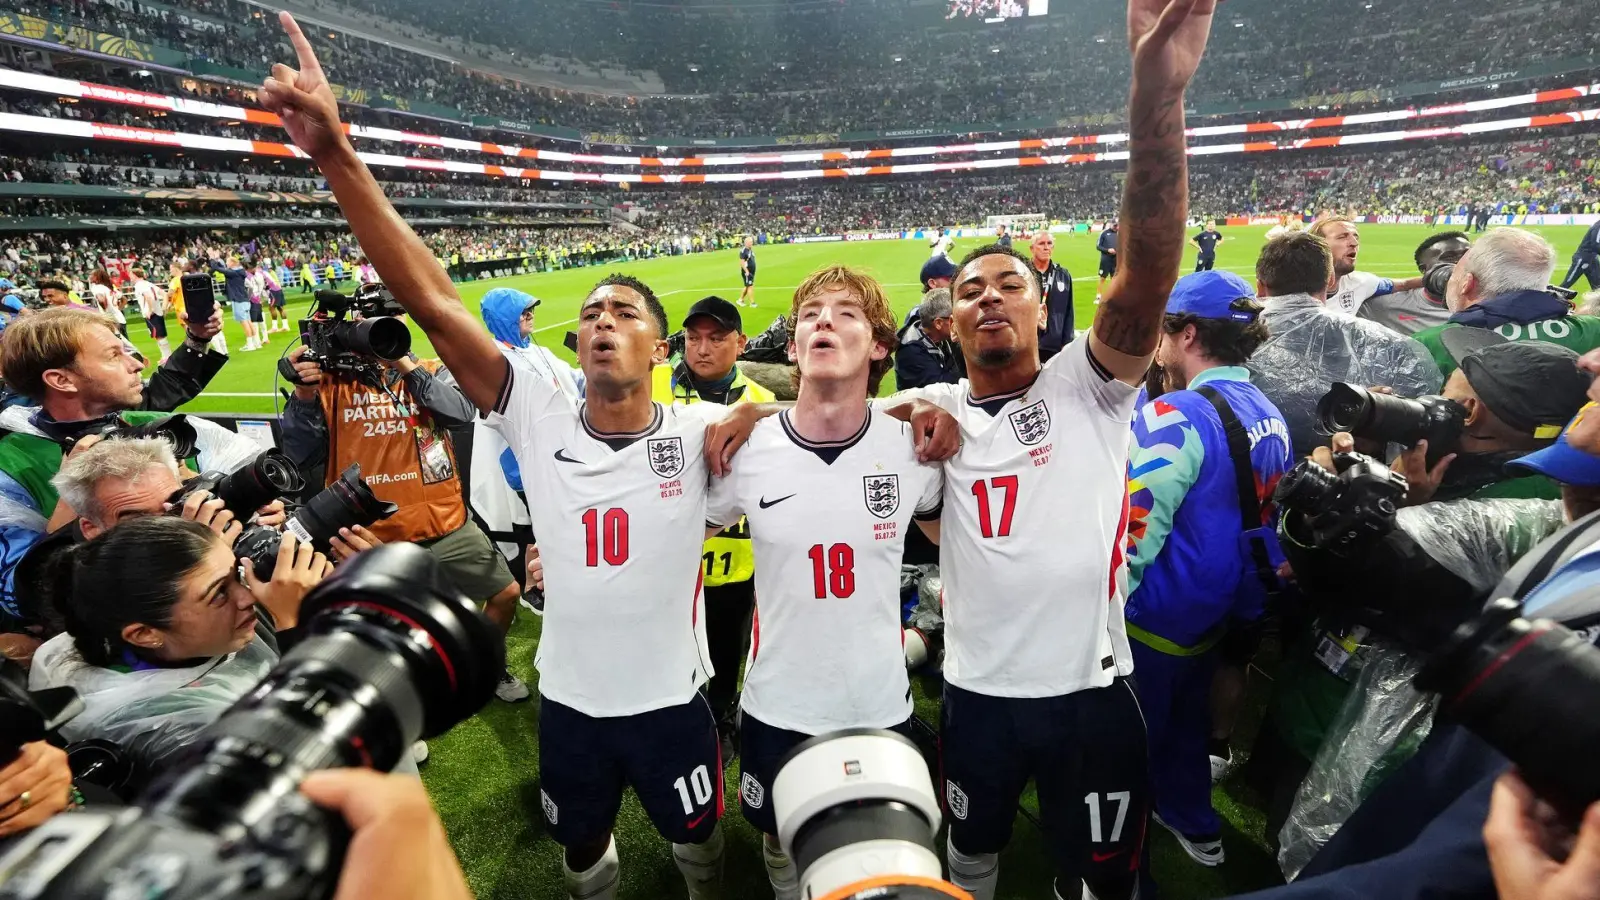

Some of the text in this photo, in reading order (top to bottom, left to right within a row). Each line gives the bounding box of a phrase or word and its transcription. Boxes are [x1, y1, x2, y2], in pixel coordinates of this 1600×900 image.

[1440, 71, 1519, 88] MEXICO CITY
[1377, 215, 1397, 224] QATAR
[846, 233, 869, 242] QATAR
[871, 232, 900, 240] AIRWAYS
[1493, 319, 1570, 341] OTO
[344, 401, 420, 422] PARTNR
[363, 420, 408, 437] 2454
[365, 471, 418, 486] FIFA.com
[659, 480, 682, 489] MEXICO
[971, 474, 1019, 538] 17
[873, 521, 897, 531] MEXICO
[875, 530, 897, 540] 05.07.26
[582, 508, 629, 567] 10
[702, 551, 732, 576] 11
[808, 542, 855, 599] 18
[674, 764, 713, 815] 10
[1084, 790, 1131, 842] 17
